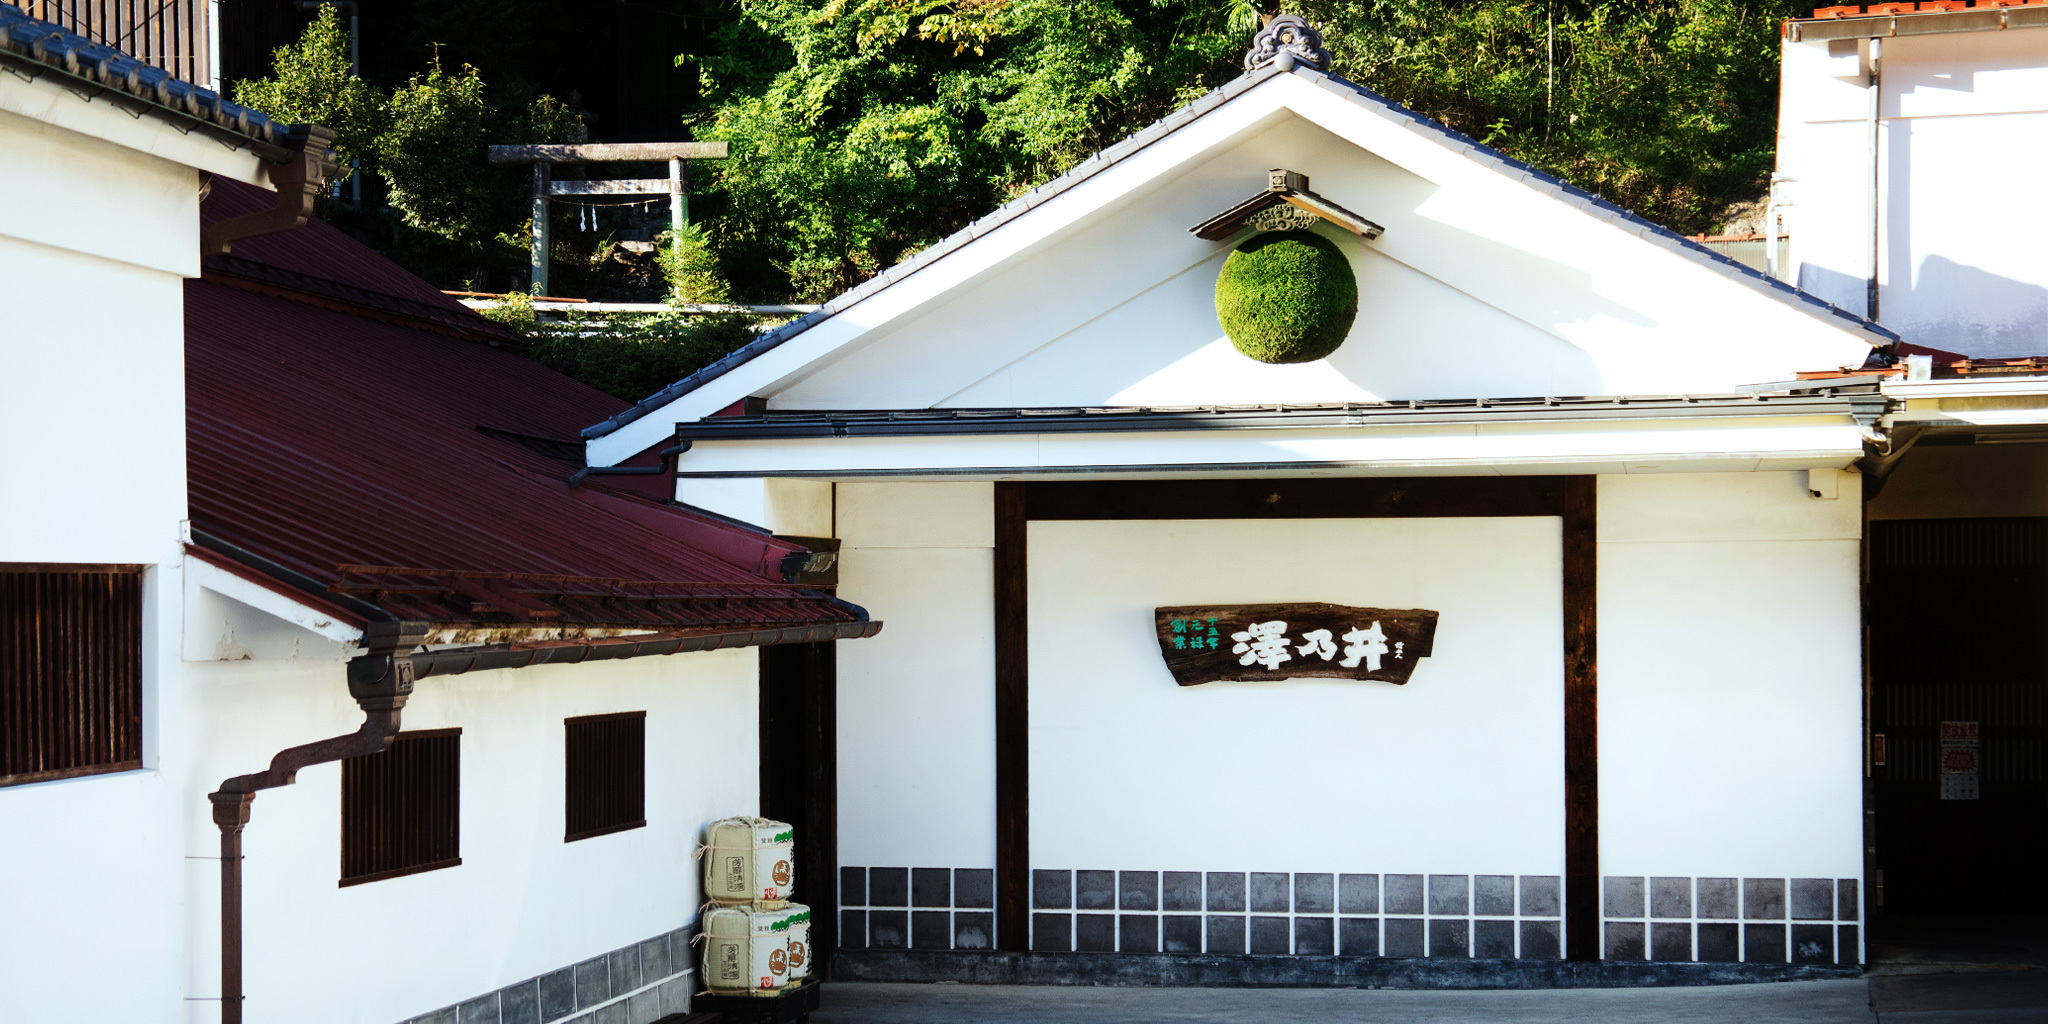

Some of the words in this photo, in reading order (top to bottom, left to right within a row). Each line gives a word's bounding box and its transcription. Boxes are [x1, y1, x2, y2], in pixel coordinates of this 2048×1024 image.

[1170, 618, 1187, 650] 創業
[1190, 619, 1205, 649] 元禄
[1206, 617, 1221, 650] 十五年
[1230, 619, 1389, 673] 澤乃井
